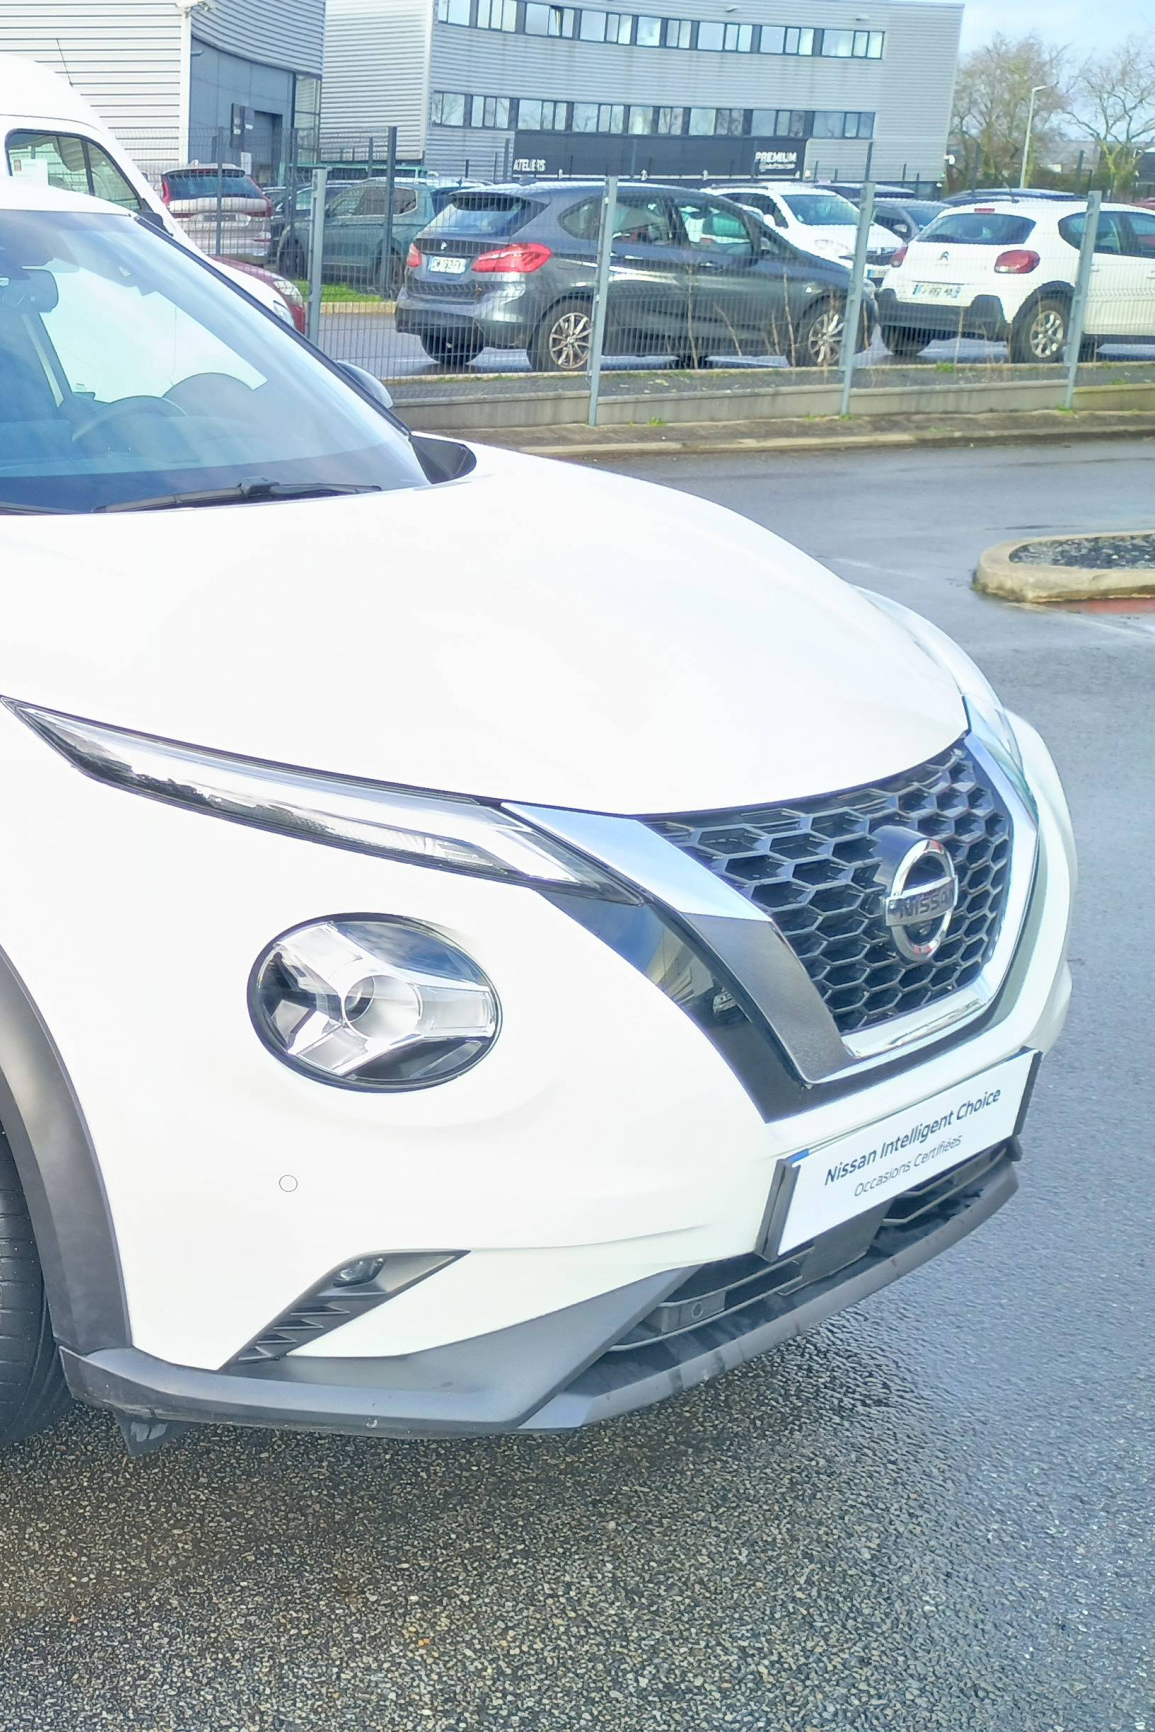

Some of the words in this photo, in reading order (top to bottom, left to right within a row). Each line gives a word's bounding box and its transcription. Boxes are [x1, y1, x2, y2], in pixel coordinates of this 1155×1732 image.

[754, 151, 798, 163] PREMIUM
[898, 884, 953, 918] NISSA
[824, 1148, 877, 1186] Nissan
[880, 1110, 955, 1159] Intelligent
[956, 1089, 1001, 1121] Choice
[854, 1160, 912, 1197] Occasions
